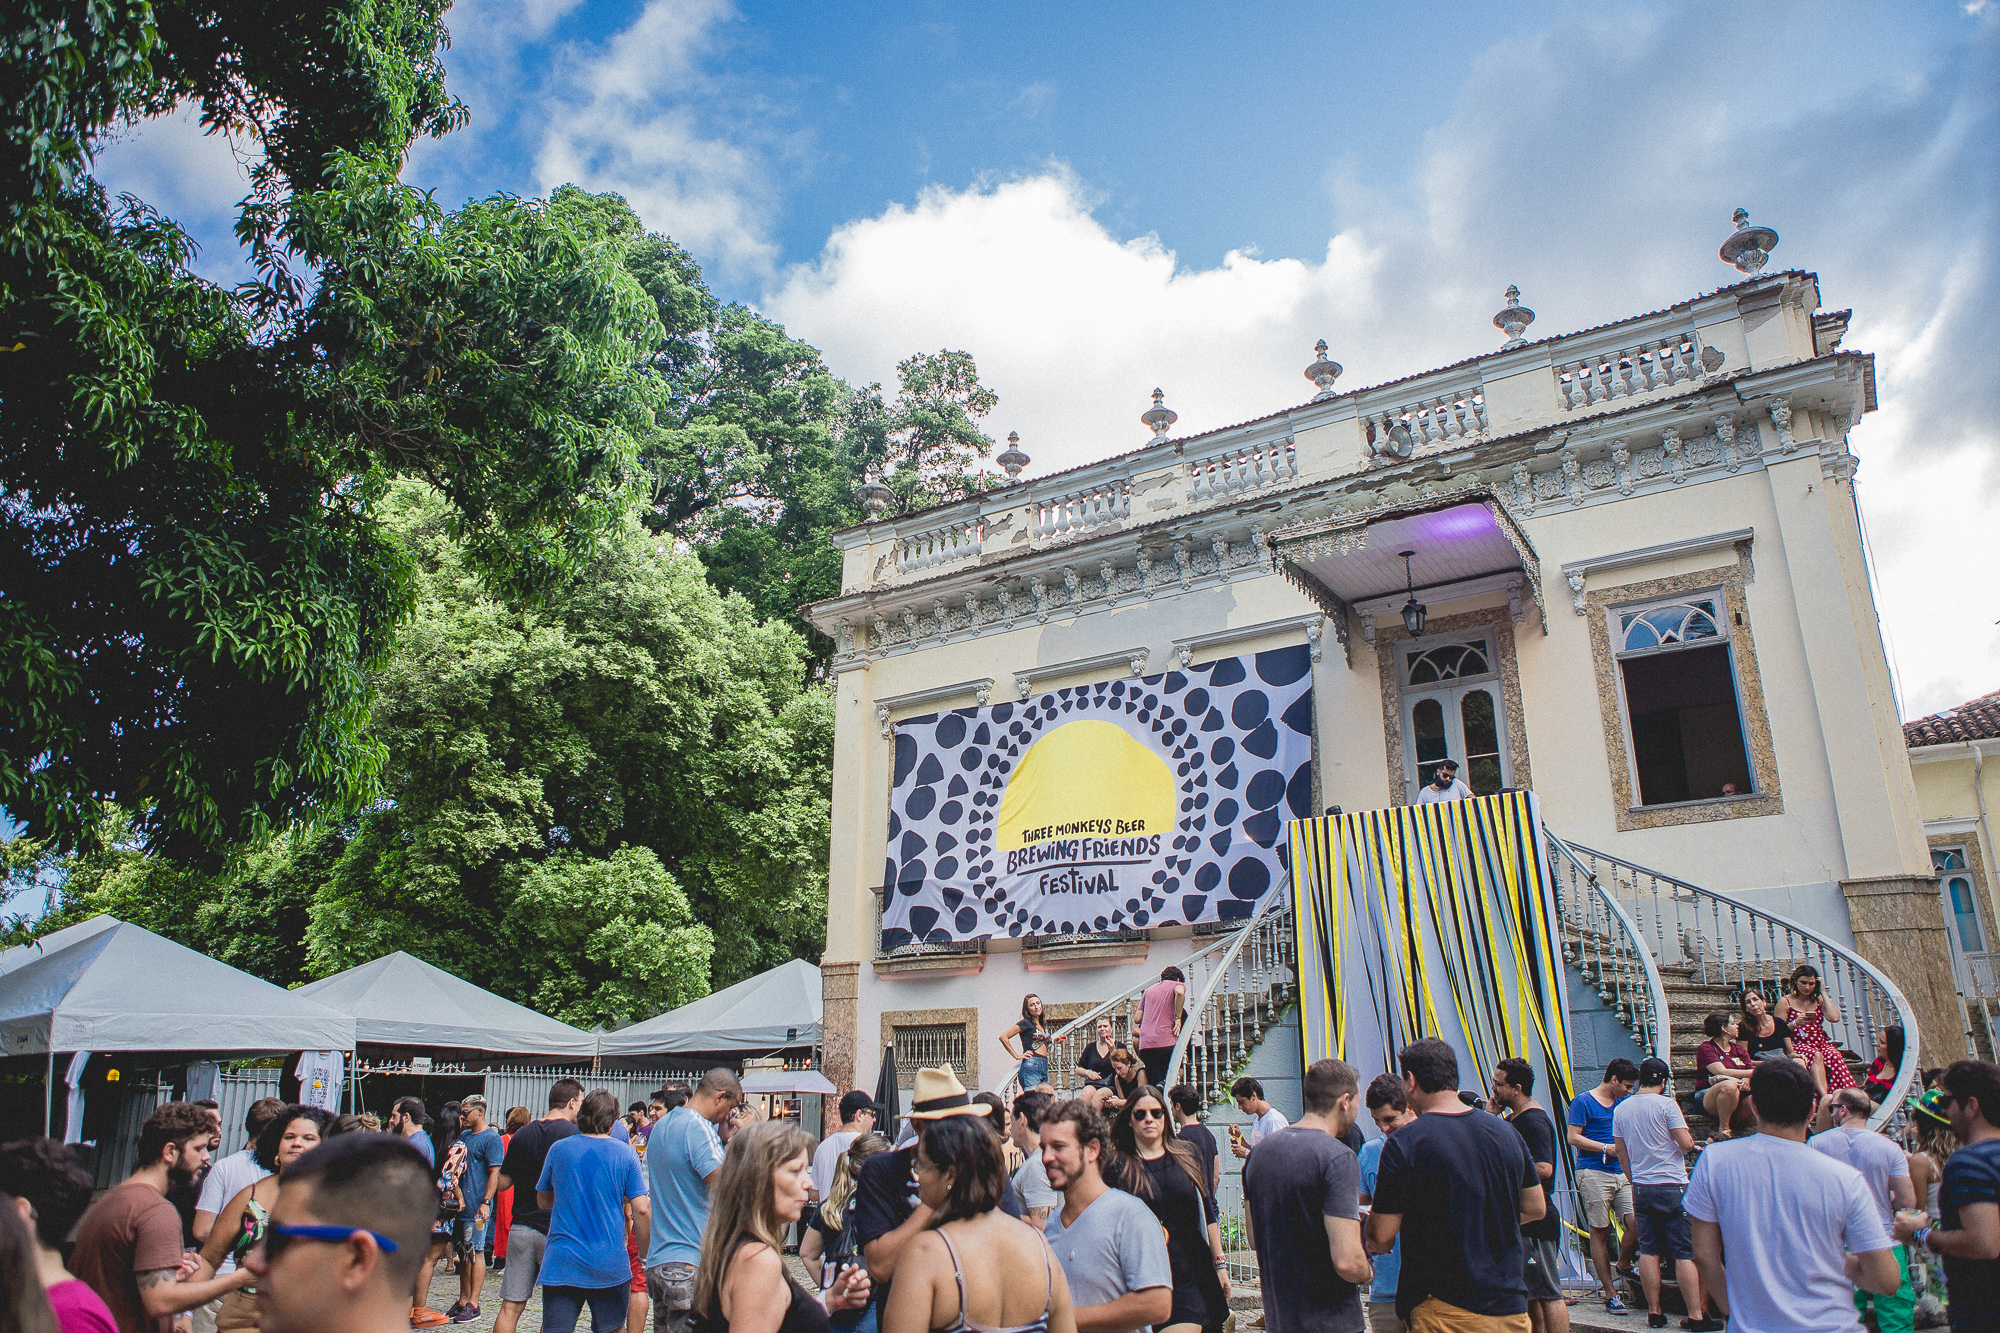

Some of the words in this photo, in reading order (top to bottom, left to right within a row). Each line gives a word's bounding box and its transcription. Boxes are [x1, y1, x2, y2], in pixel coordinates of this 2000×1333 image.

[1022, 825, 1053, 843] THREE
[1055, 819, 1112, 835] MONKEYS
[1115, 819, 1145, 834] BEER
